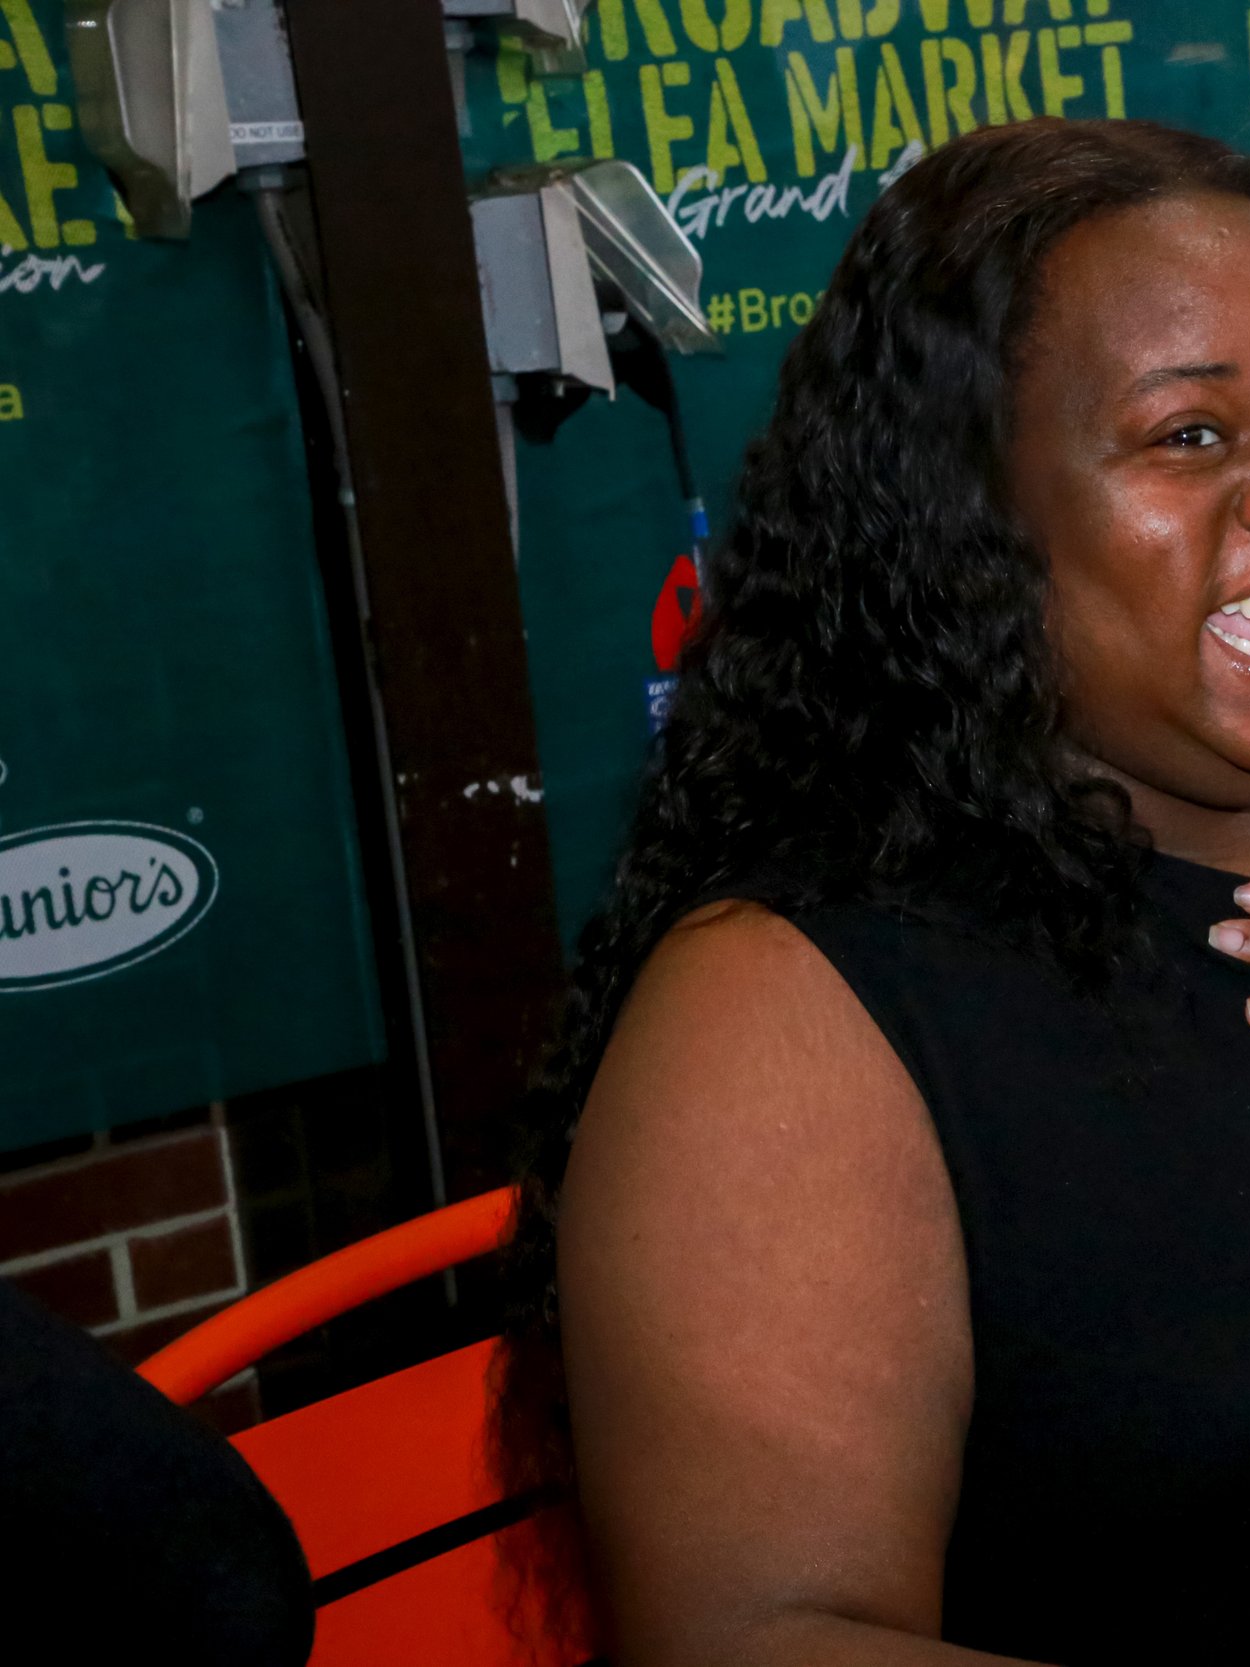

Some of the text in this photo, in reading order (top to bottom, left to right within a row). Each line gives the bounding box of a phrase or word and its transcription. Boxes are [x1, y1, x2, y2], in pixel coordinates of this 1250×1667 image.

[249, 126, 273, 138] NOT
[785, 20, 1133, 177] MARKET
[668, 143, 857, 238] Grand
[707, 287, 825, 335] #Bro
